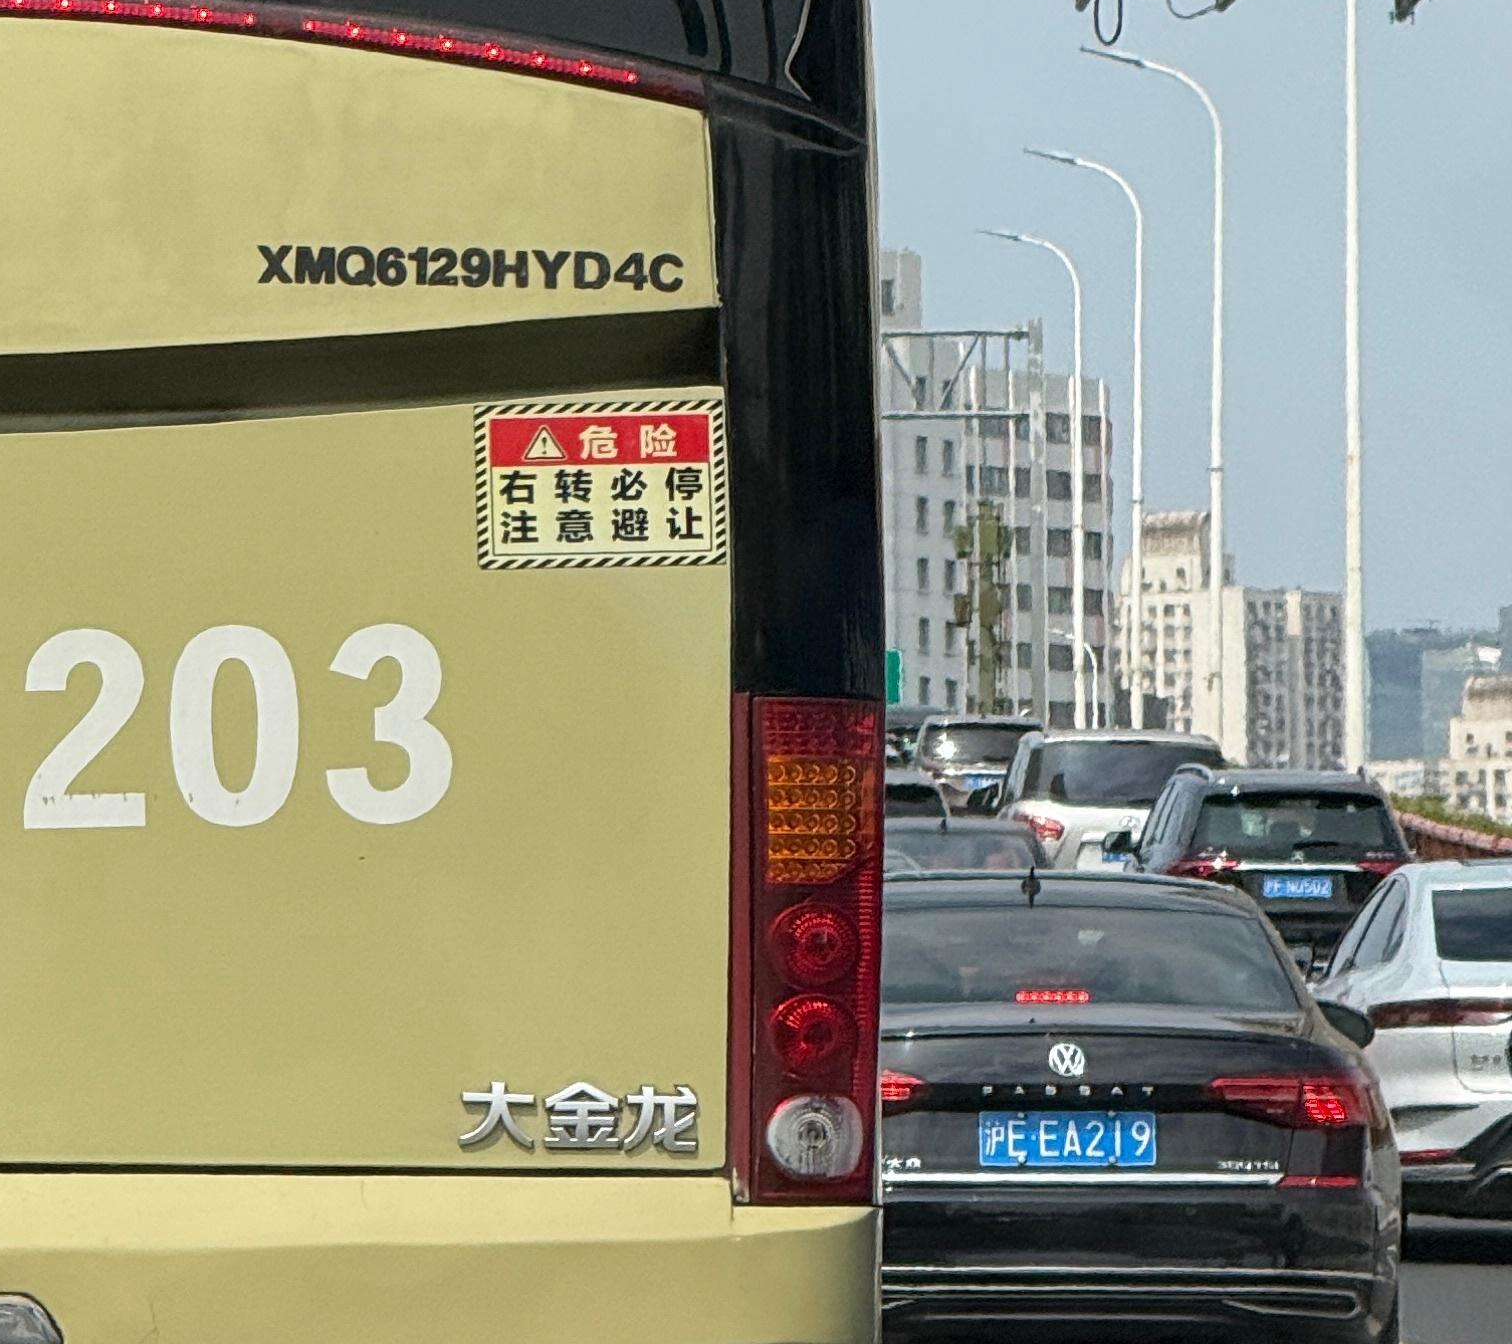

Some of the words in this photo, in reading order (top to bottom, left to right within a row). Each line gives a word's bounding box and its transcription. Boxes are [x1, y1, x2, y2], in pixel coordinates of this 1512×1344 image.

[257, 244, 684, 293] XMQ6129HYD4C
[579, 424, 678, 460] 危险
[500, 468, 705, 506] 右转必停
[500, 508, 705, 545] 注意避让
[458, 1081, 699, 1152] 大金龙
